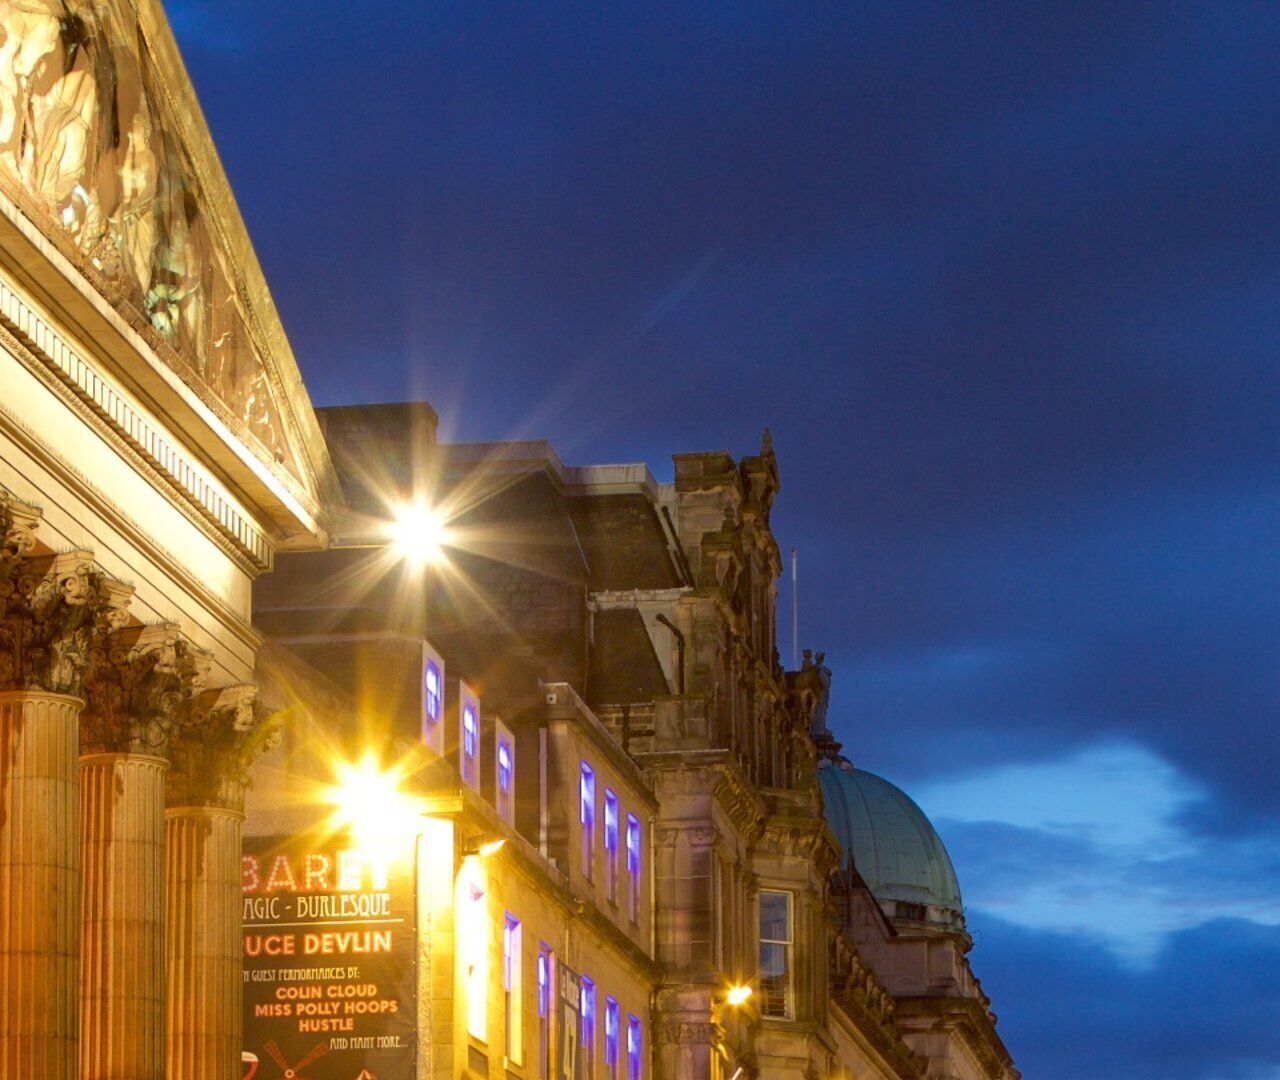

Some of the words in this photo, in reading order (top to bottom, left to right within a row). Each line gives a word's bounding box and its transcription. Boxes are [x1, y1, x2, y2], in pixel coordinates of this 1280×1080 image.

[297, 893, 391, 918] BURLESQUE
[245, 934, 295, 955] UCE
[304, 931, 392, 954] DEVLIN
[276, 987, 322, 999] COLIN
[327, 984, 377, 997] CLOUD
[255, 1003, 292, 1016] MISS
[296, 1001, 341, 1015] POLLY
[344, 1000, 399, 1013] HOOPS
[298, 1018, 354, 1032] HUSTLE
[330, 1038, 348, 1049] AND
